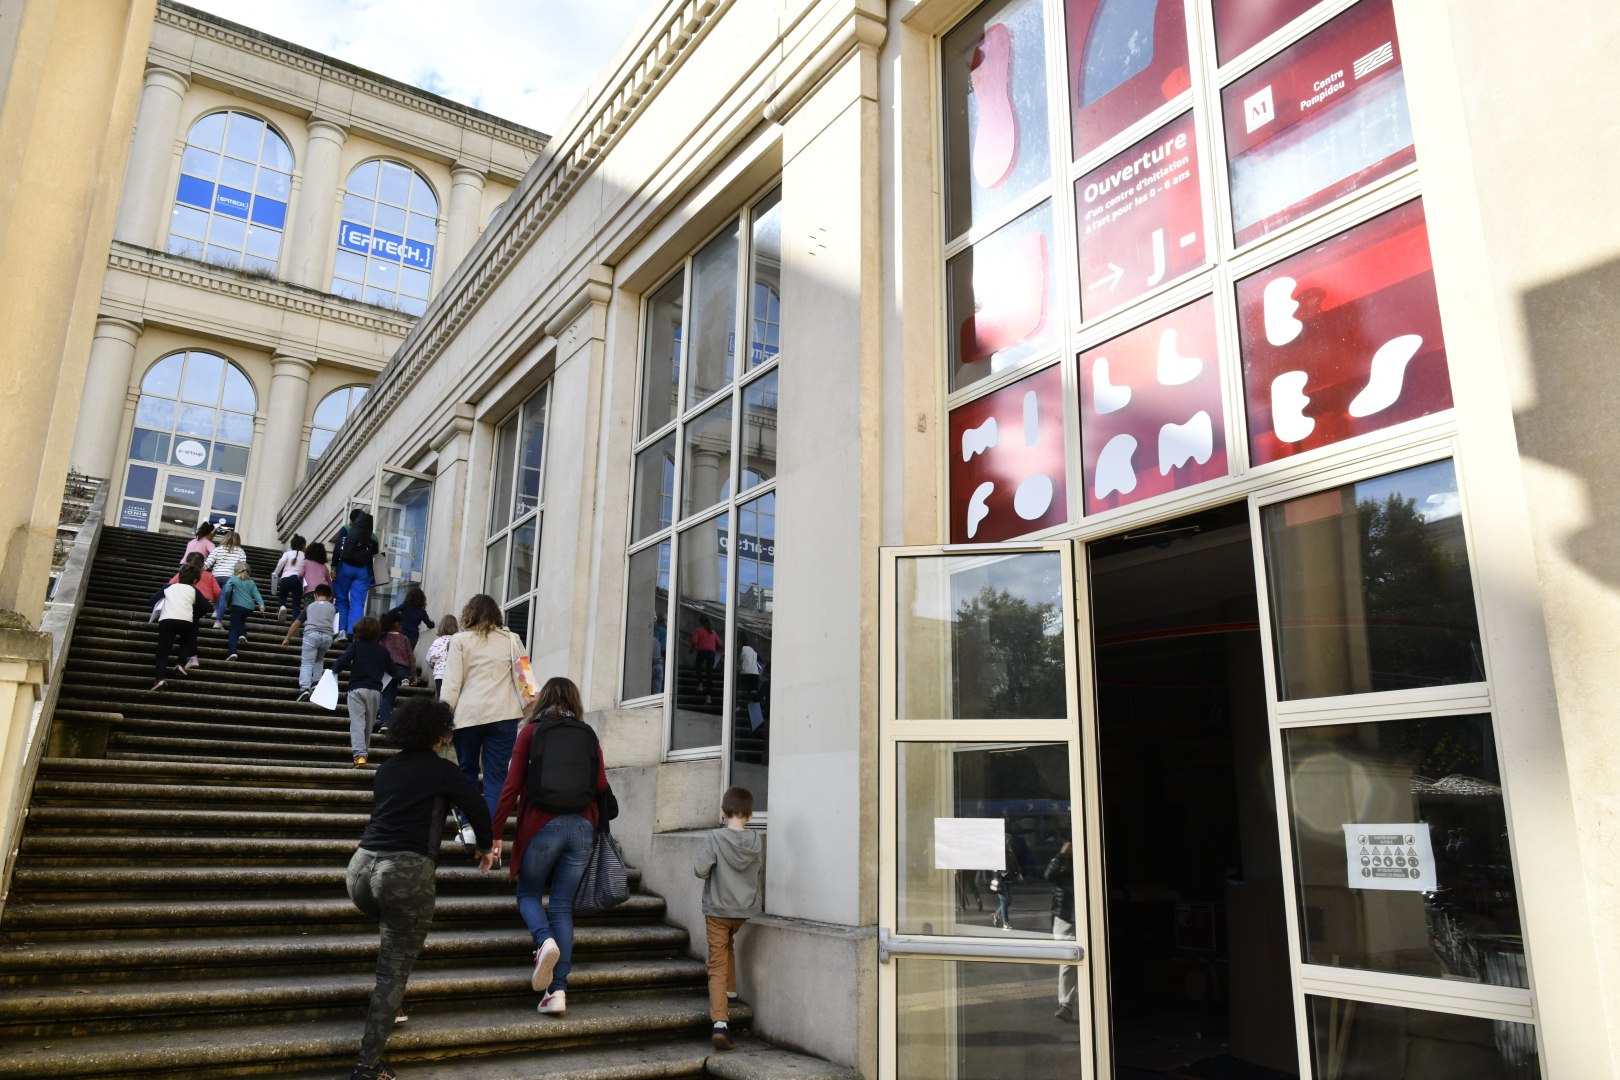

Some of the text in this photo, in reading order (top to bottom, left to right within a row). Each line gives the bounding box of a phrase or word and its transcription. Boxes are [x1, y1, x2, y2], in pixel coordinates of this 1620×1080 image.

[1300, 80, 1345, 111] Pompidou
[1313, 69, 1344, 92] Centre
[1252, 101, 1267, 120] M
[1084, 133, 1187, 203] Ouverture
[1085, 156, 1189, 221] d'un centre d'initiation
[1085, 225, 1091, 234] à
[1093, 215, 1111, 229] l'art
[1112, 202, 1133, 221] pour
[1134, 193, 1148, 206] les
[1164, 179, 1171, 189] 6
[1172, 169, 1190, 185] ans
